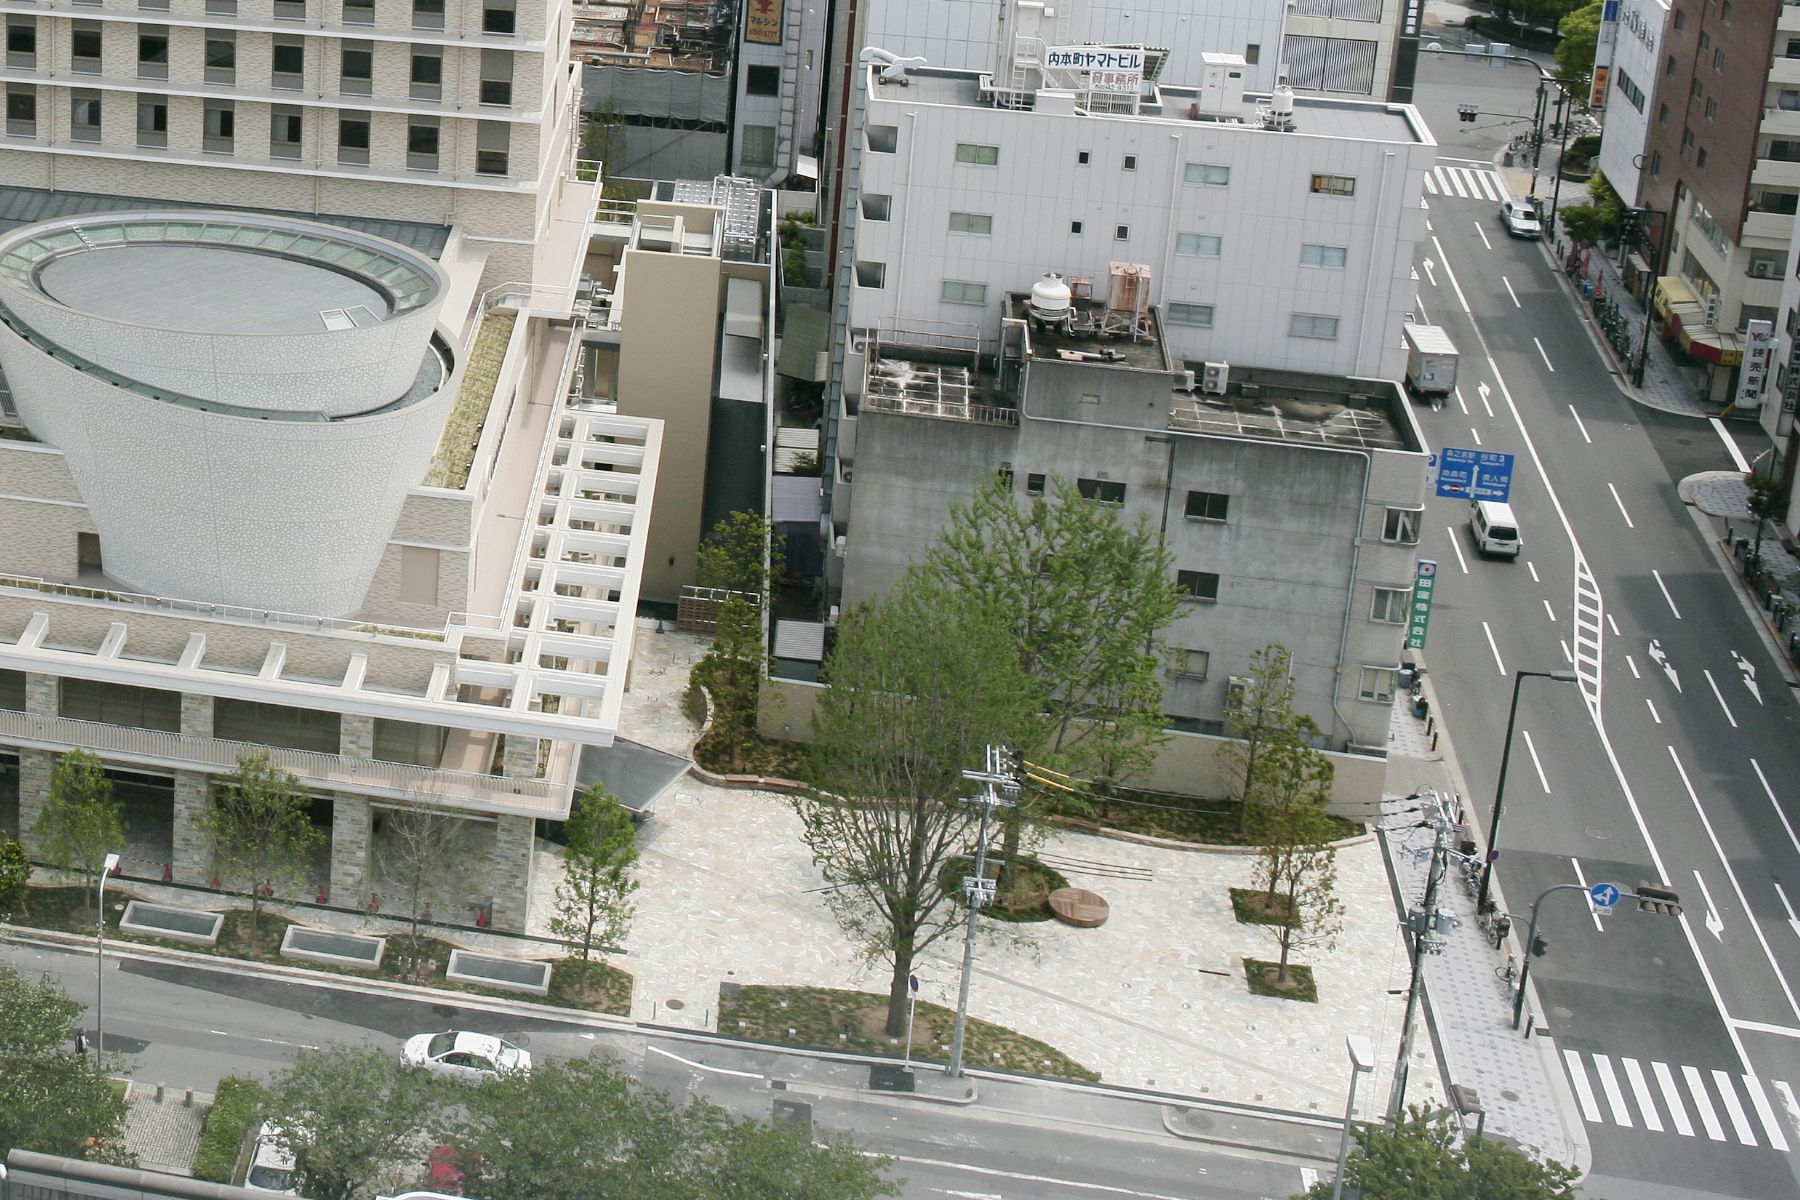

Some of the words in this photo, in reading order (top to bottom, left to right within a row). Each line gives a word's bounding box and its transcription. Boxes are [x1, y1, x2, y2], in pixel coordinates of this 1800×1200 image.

[750, 16, 779, 27] マルシン
[1048, 51, 1141, 69] 内本町ヤマトビル
[1092, 70, 1140, 85] 貸事務所
[1744, 347, 1766, 400] 読売新聞
